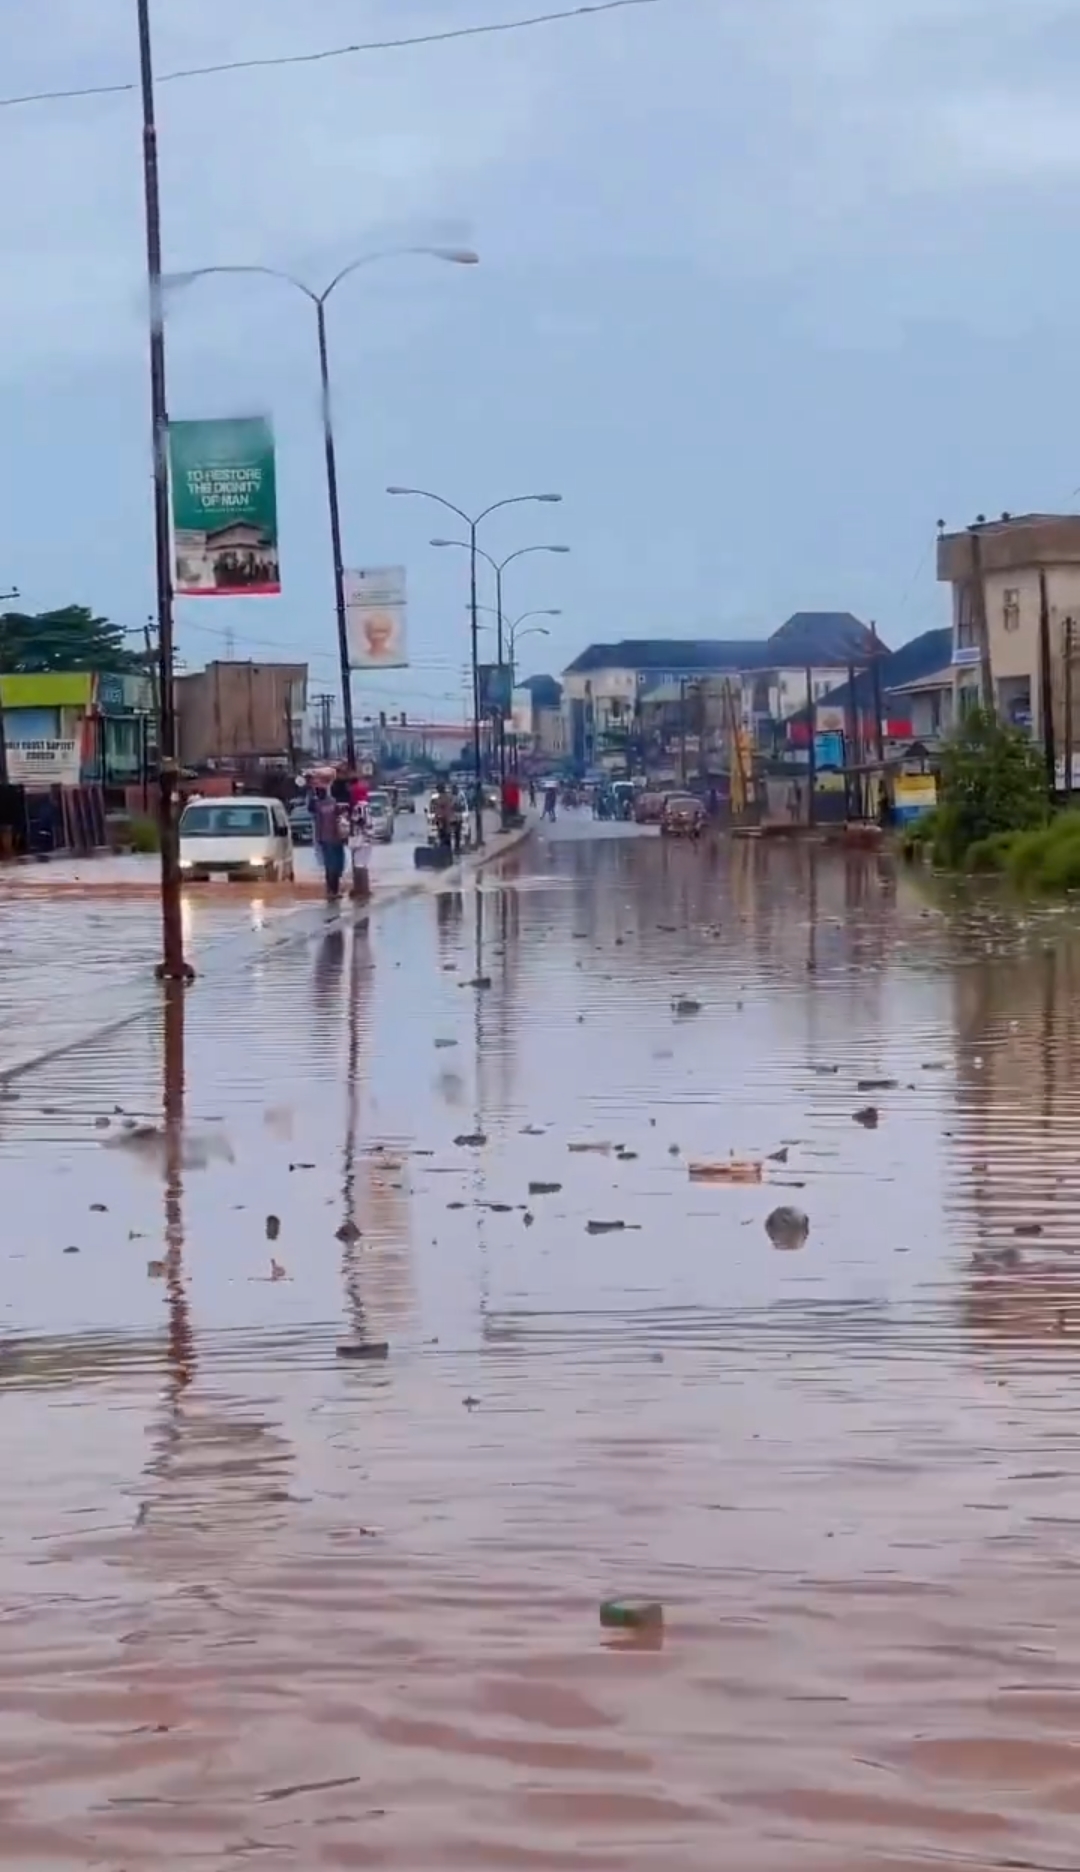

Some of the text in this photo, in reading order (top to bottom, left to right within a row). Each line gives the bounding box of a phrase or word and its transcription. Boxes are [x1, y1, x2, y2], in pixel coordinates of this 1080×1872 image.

[187, 469, 262, 482] TO RESTORE
[187, 481, 261, 494] THE DIGNITY
[202, 494, 249, 507] OF MAN
